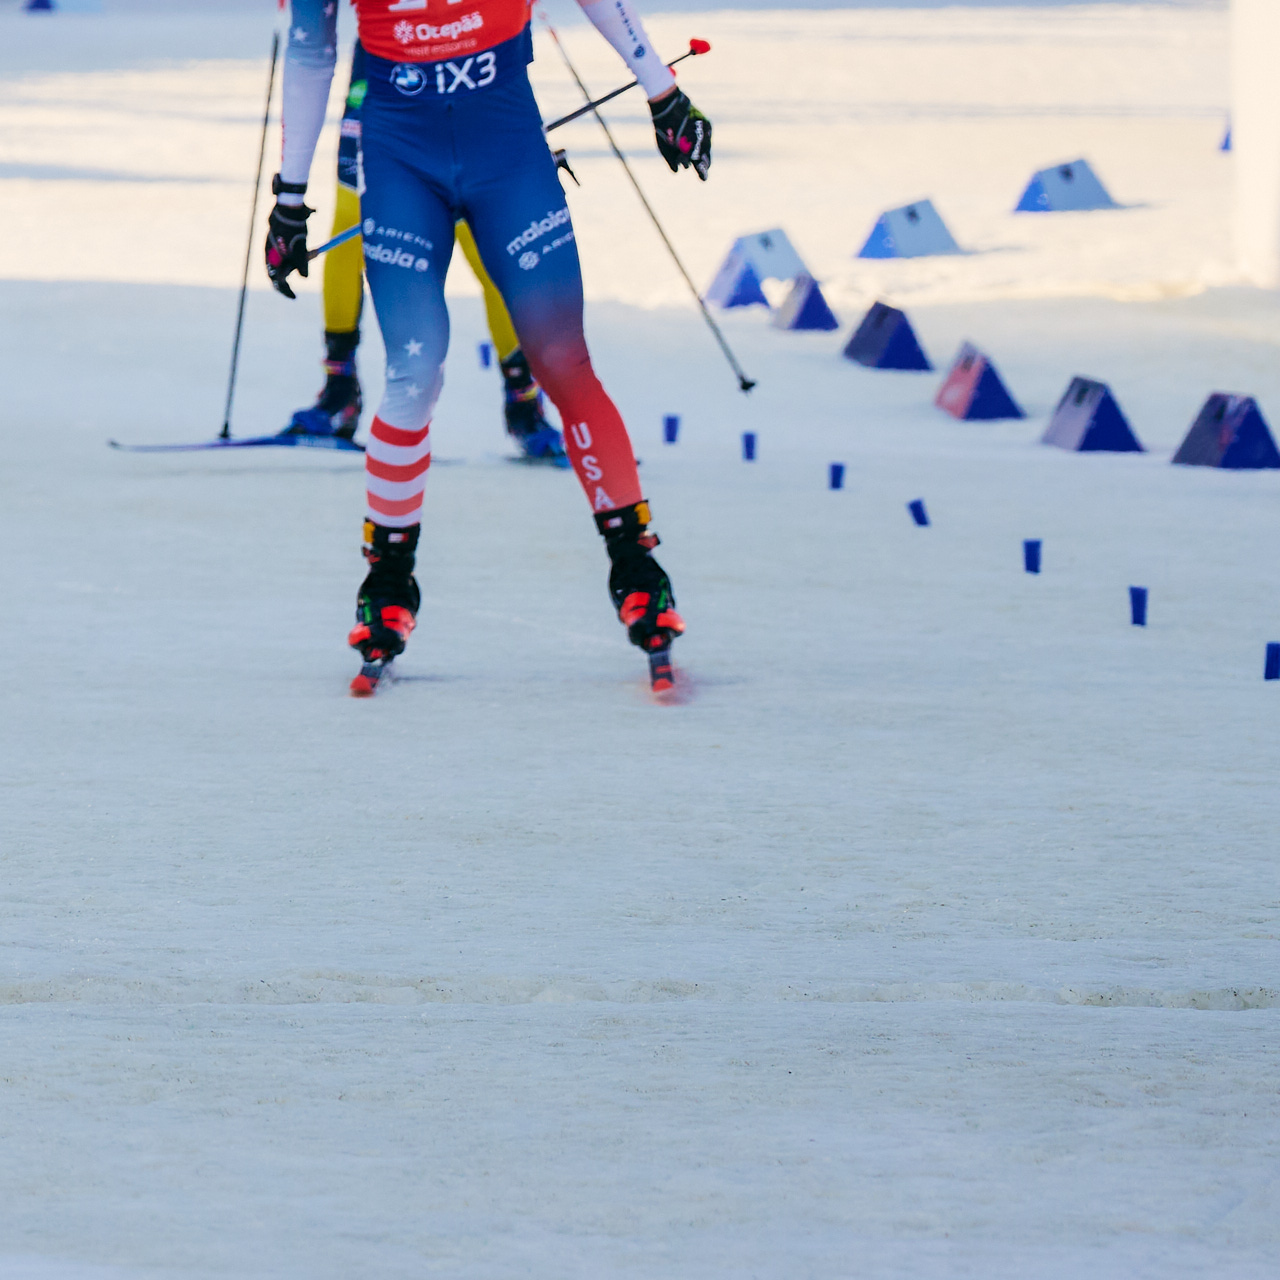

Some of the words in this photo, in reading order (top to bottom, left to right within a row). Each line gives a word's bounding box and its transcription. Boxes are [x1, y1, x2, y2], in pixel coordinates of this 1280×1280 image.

[415, 11, 484, 41] Otepää
[435, 51, 497, 94] iX3
[375, 225, 434, 251] ARIENS
[571, 422, 616, 510] USA
